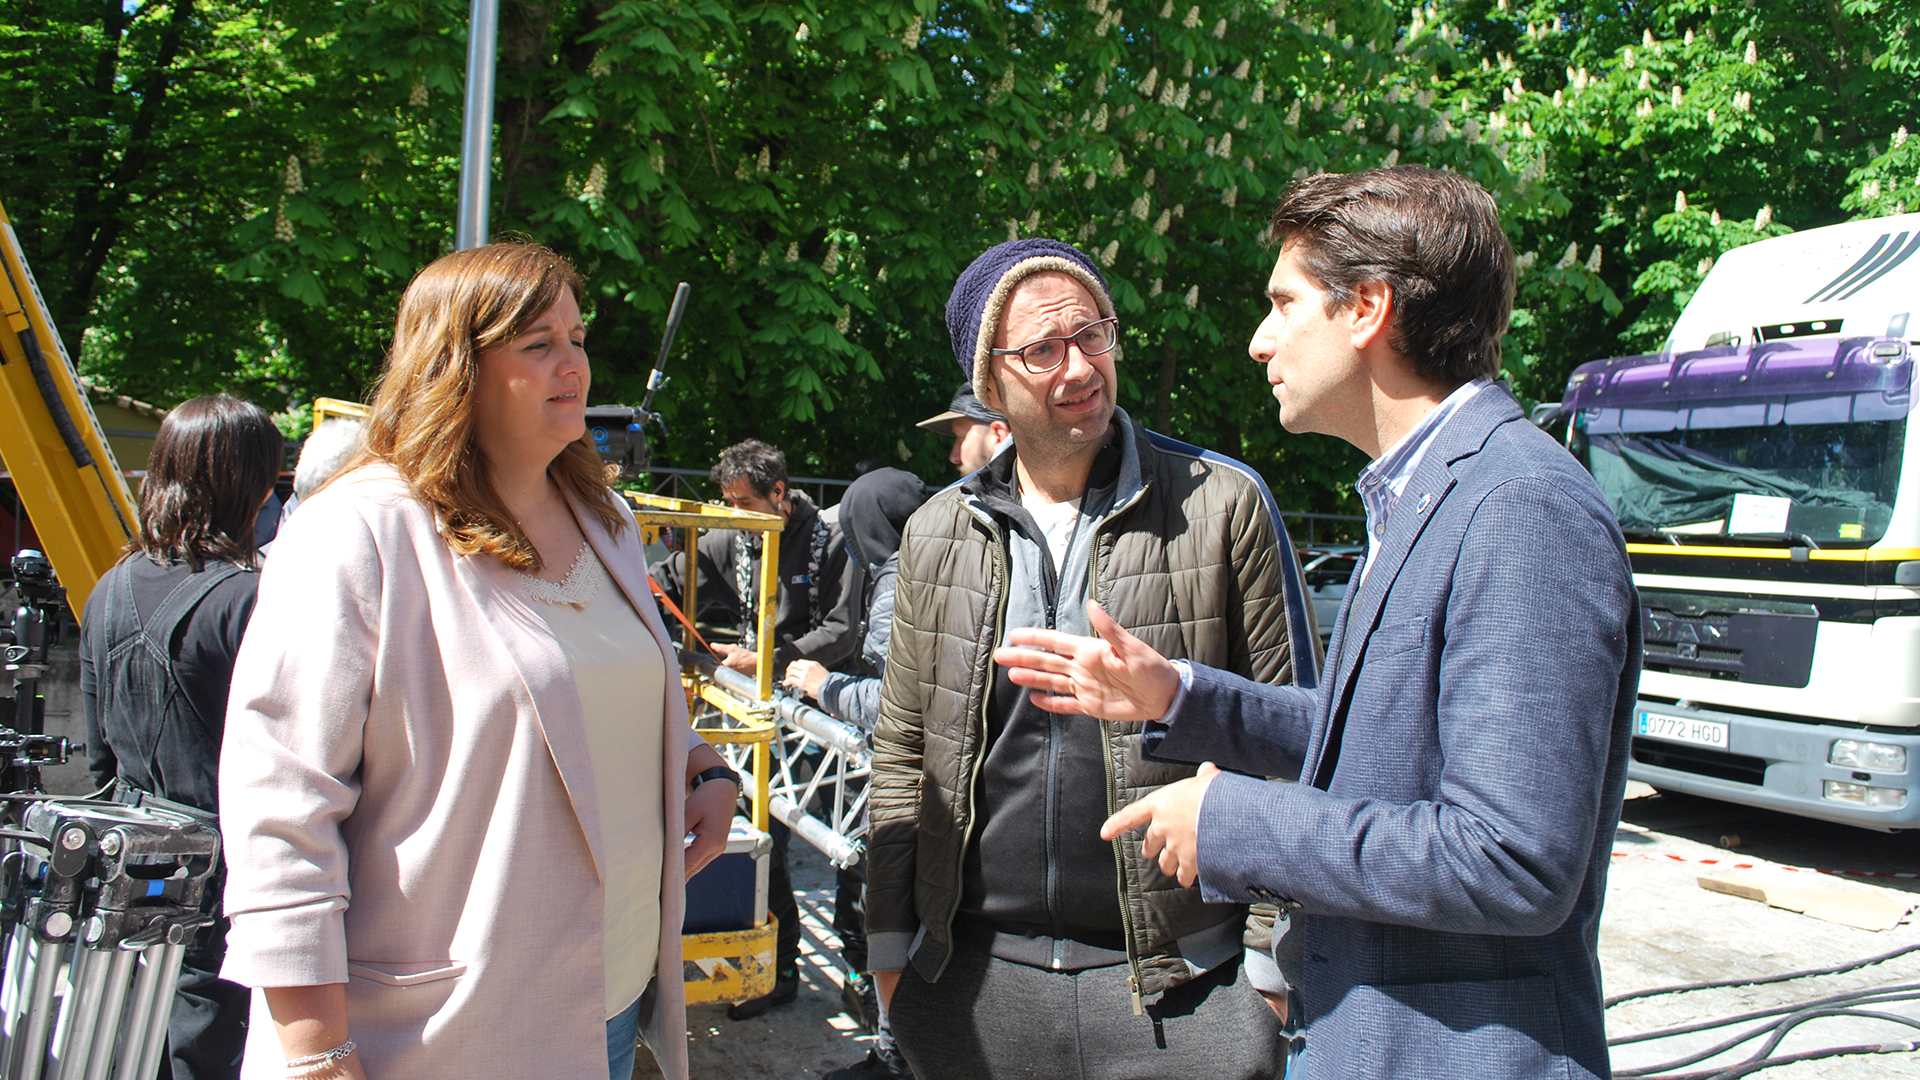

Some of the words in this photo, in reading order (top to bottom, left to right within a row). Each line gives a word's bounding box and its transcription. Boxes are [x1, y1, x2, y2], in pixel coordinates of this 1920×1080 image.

[1647, 620, 1729, 646] MAN
[1648, 717, 1686, 738] 0772
[1691, 723, 1721, 743] HGD
